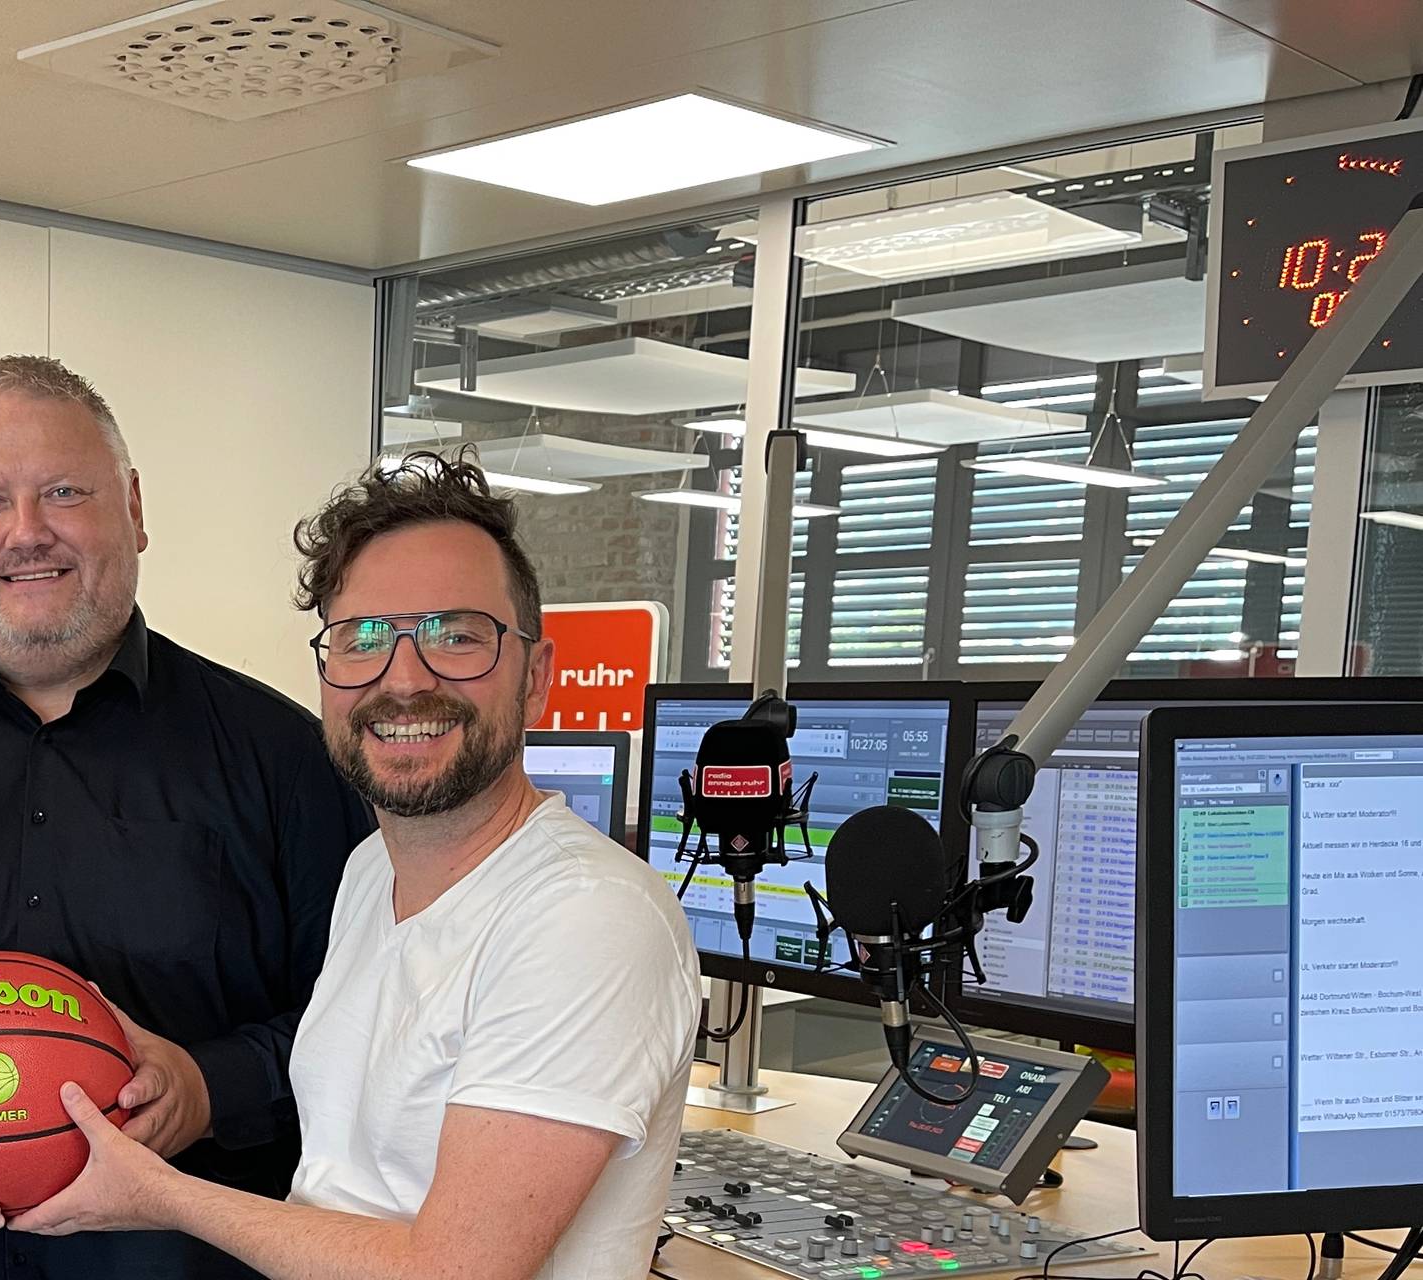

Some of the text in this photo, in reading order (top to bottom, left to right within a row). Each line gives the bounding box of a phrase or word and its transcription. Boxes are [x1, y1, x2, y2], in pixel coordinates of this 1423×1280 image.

[1279, 232, 1386, 290] 10:2
[1309, 290, 1350, 328] 0
[560, 662, 634, 687] ruhr
[849, 739, 888, 751] 10:27:05
[902, 730, 929, 742] 05:55
